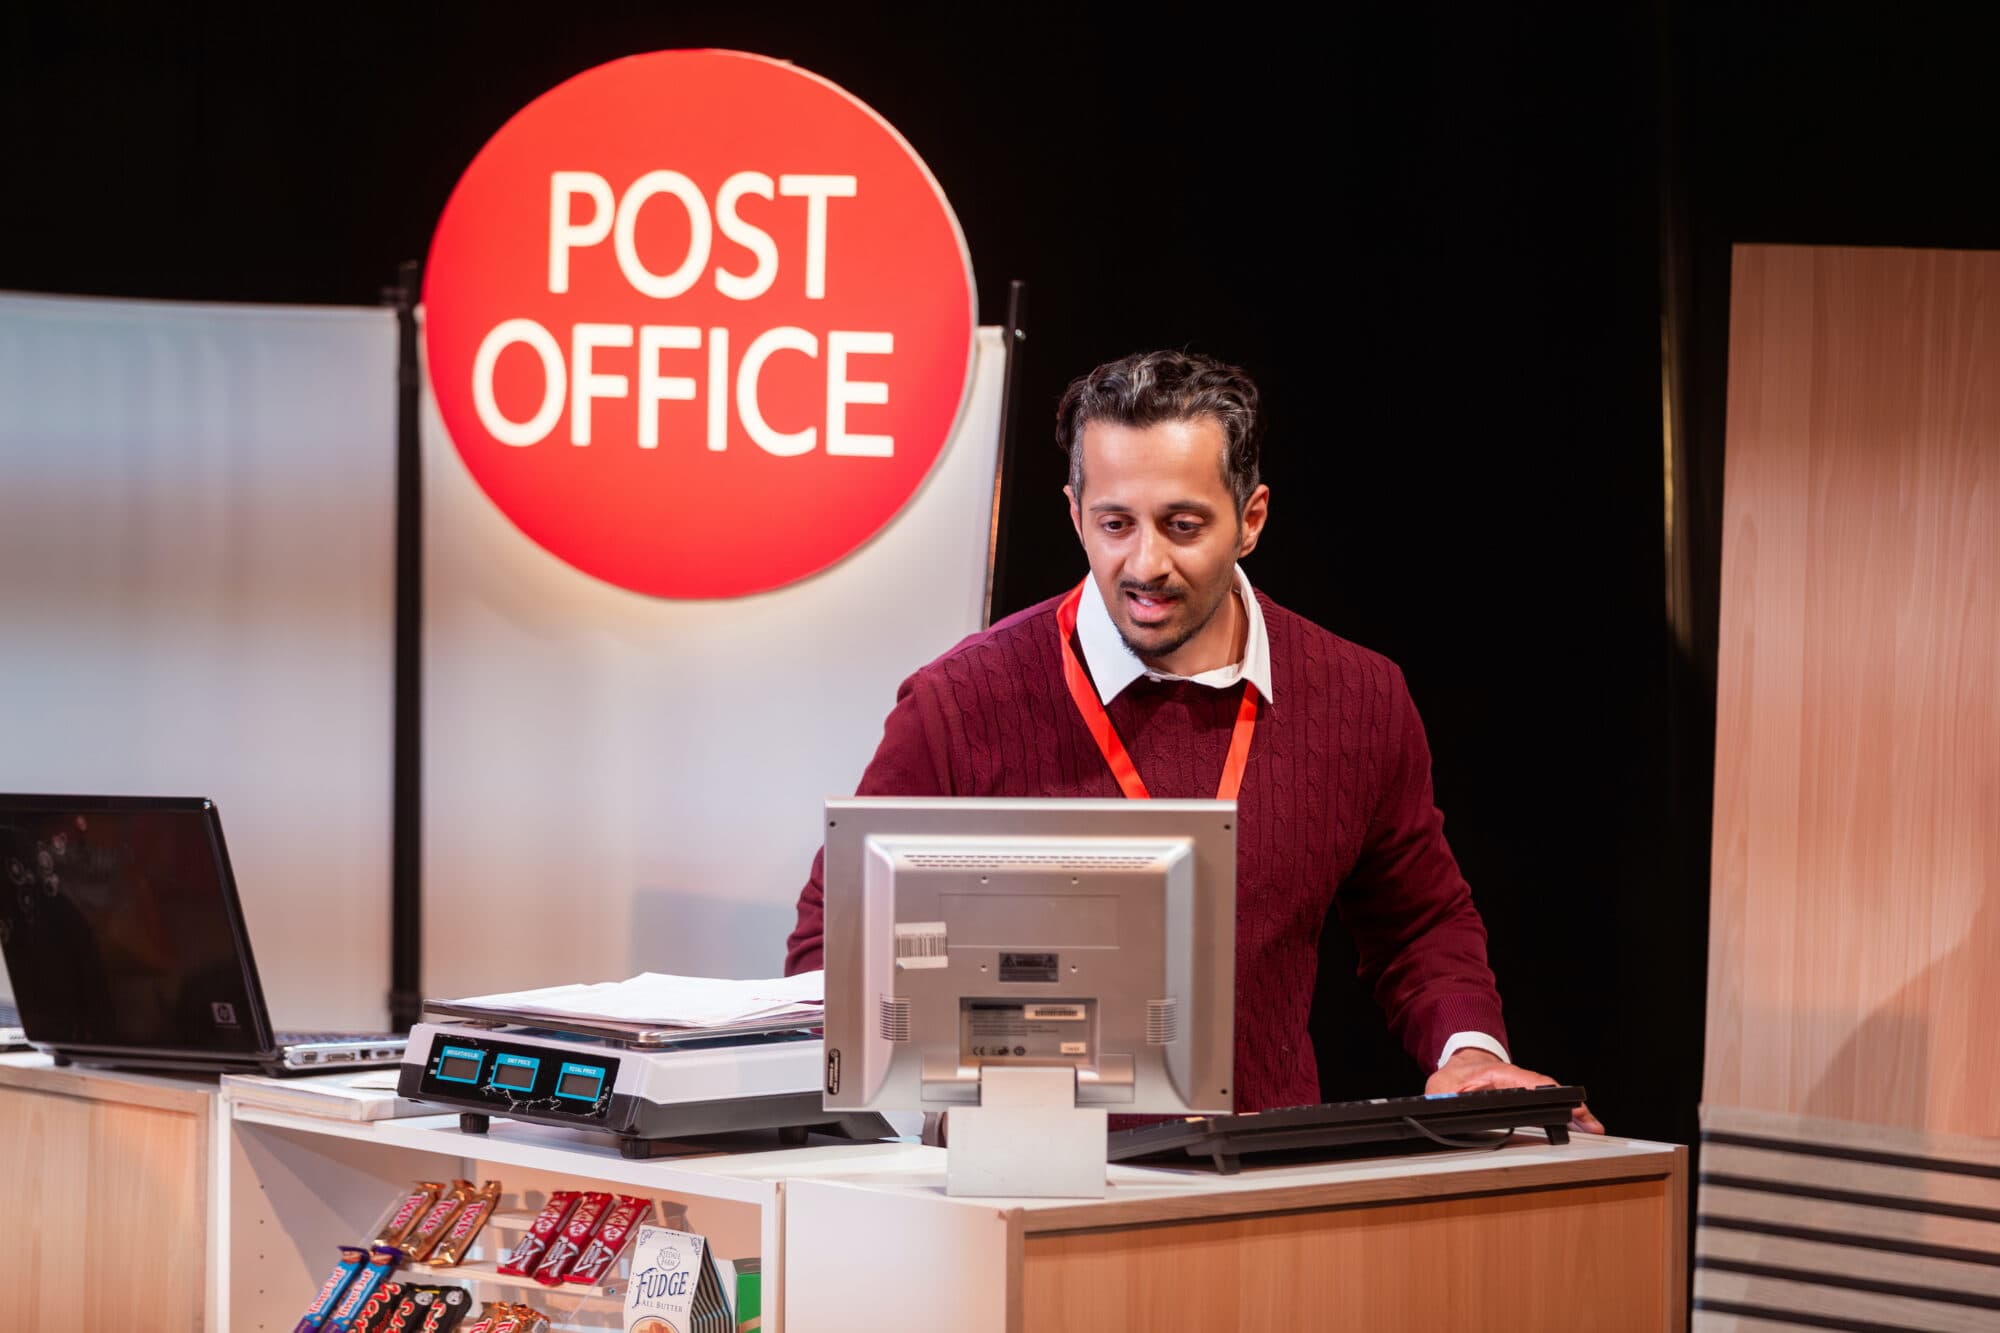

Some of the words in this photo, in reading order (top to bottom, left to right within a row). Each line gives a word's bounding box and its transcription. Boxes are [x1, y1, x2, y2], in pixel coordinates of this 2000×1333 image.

[548, 169, 857, 300] POST
[472, 318, 894, 458] OFFICE
[347, 1283, 401, 1333] Mar
[632, 1267, 689, 1309] FUDGE
